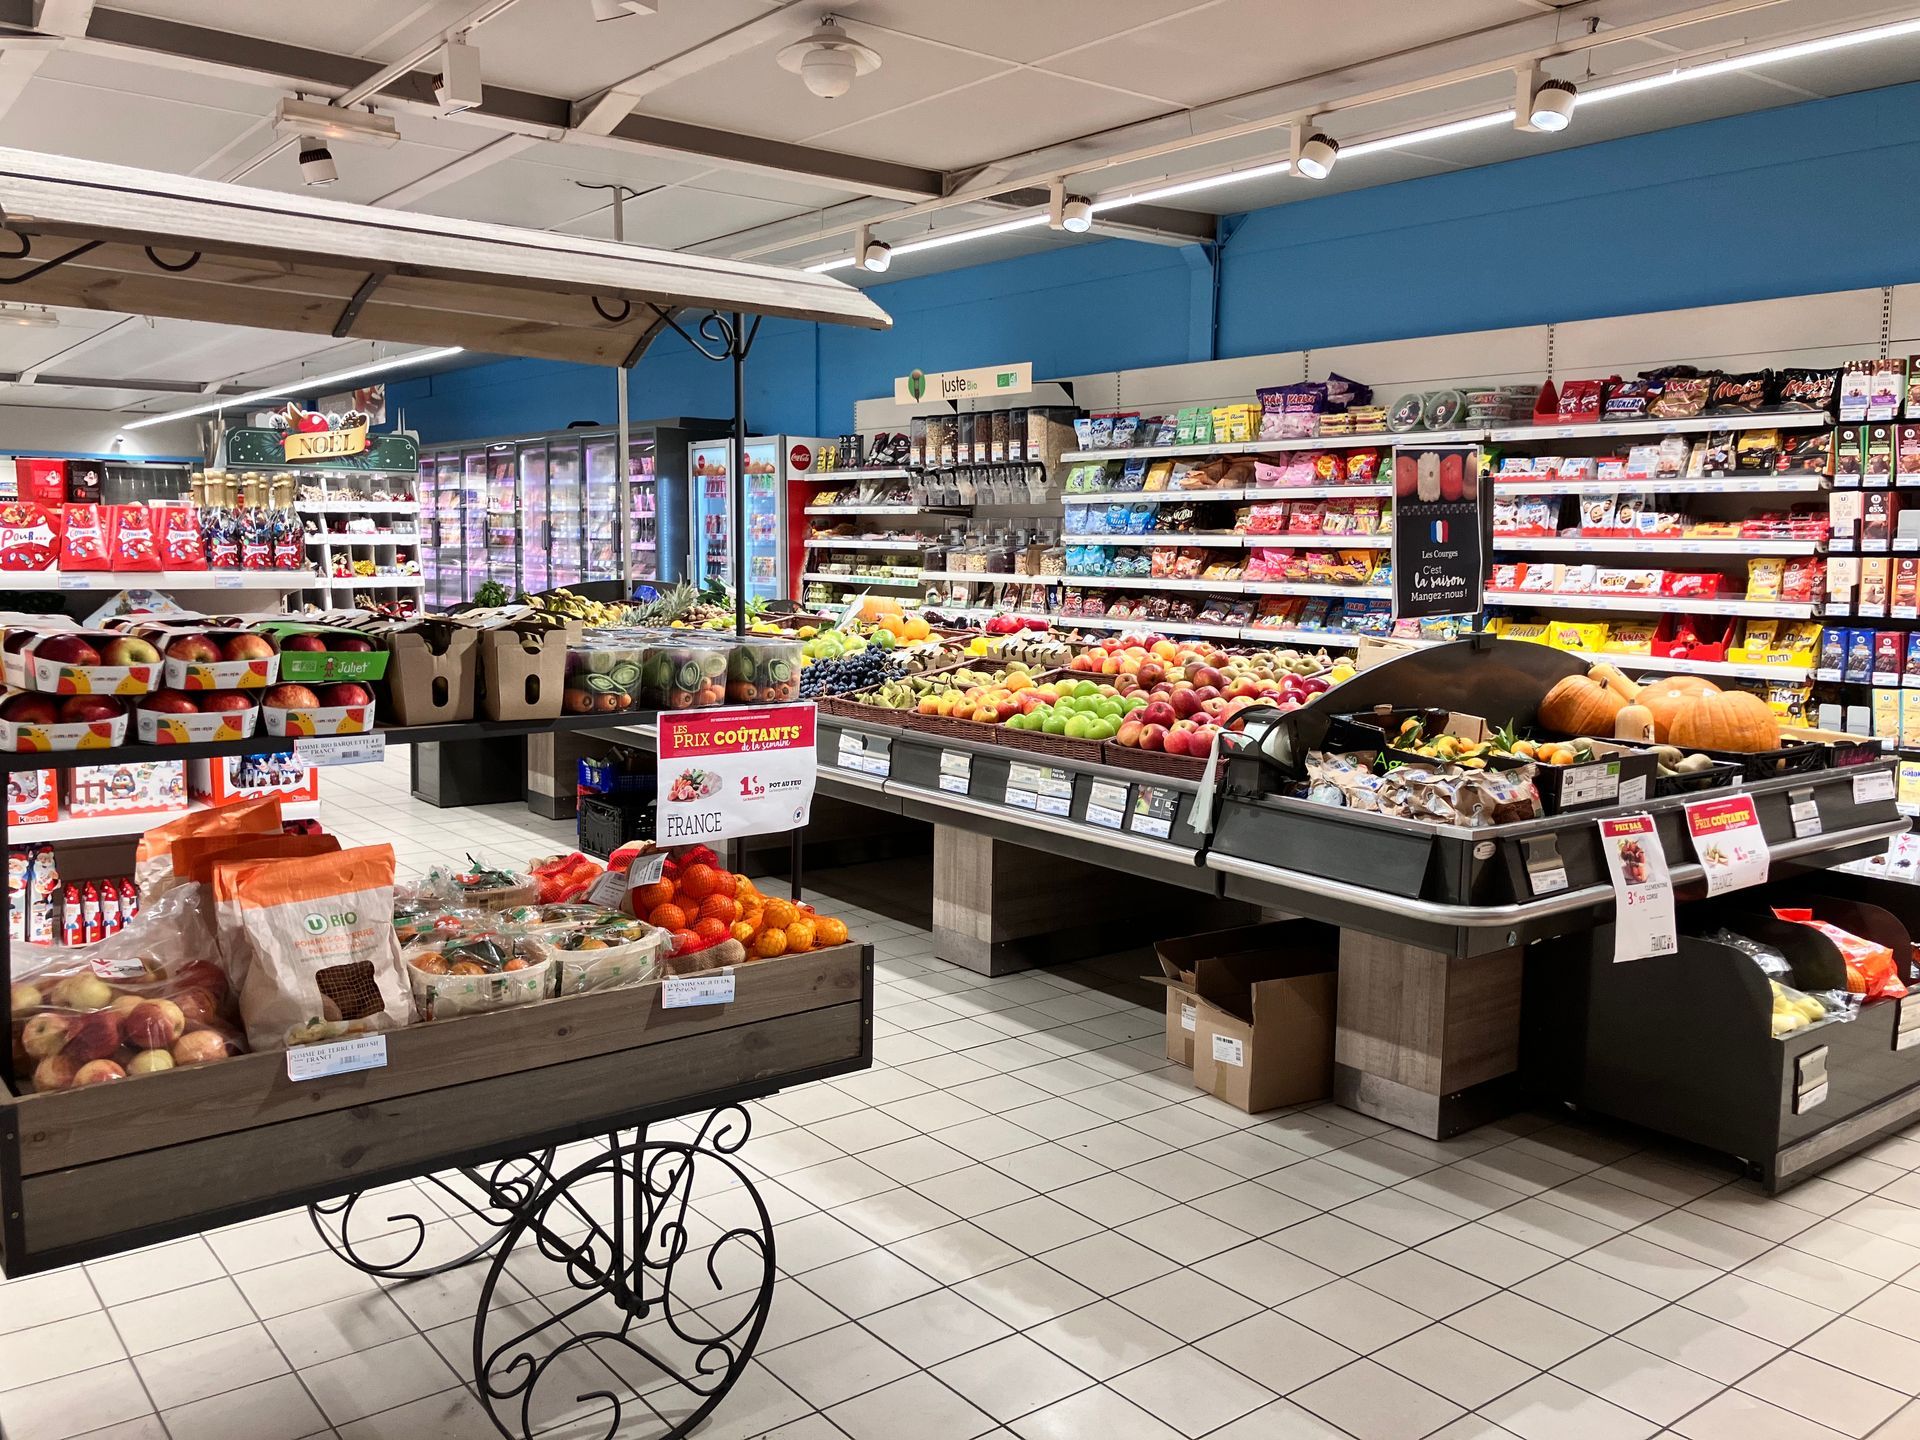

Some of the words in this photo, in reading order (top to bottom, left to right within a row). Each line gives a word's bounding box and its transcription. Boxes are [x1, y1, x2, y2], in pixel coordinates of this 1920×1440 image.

[942, 374, 966, 398] juste
[967, 381, 978, 390] Bio
[1605, 399, 1642, 410] SNICKERS
[299, 431, 355, 456] NOËL
[1422, 550, 1433, 559] Les
[1434, 550, 1458, 559] Courges
[1423, 565, 1442, 575] C'est
[1415, 572, 1428, 588] la
[1430, 575, 1466, 588] saison
[1600, 575, 1627, 587] Cards
[337, 661, 369, 674] Juliet
[673, 725, 687, 734] LES
[673, 733, 710, 748] PRIX
[713, 726, 800, 746] COÛTANTS
[741, 743, 750, 752] de
[751, 740, 761, 751] la
[762, 738, 791, 751] semaine
[667, 812, 722, 837] FRANCE
[306, 1054, 332, 1063] FRANCE
